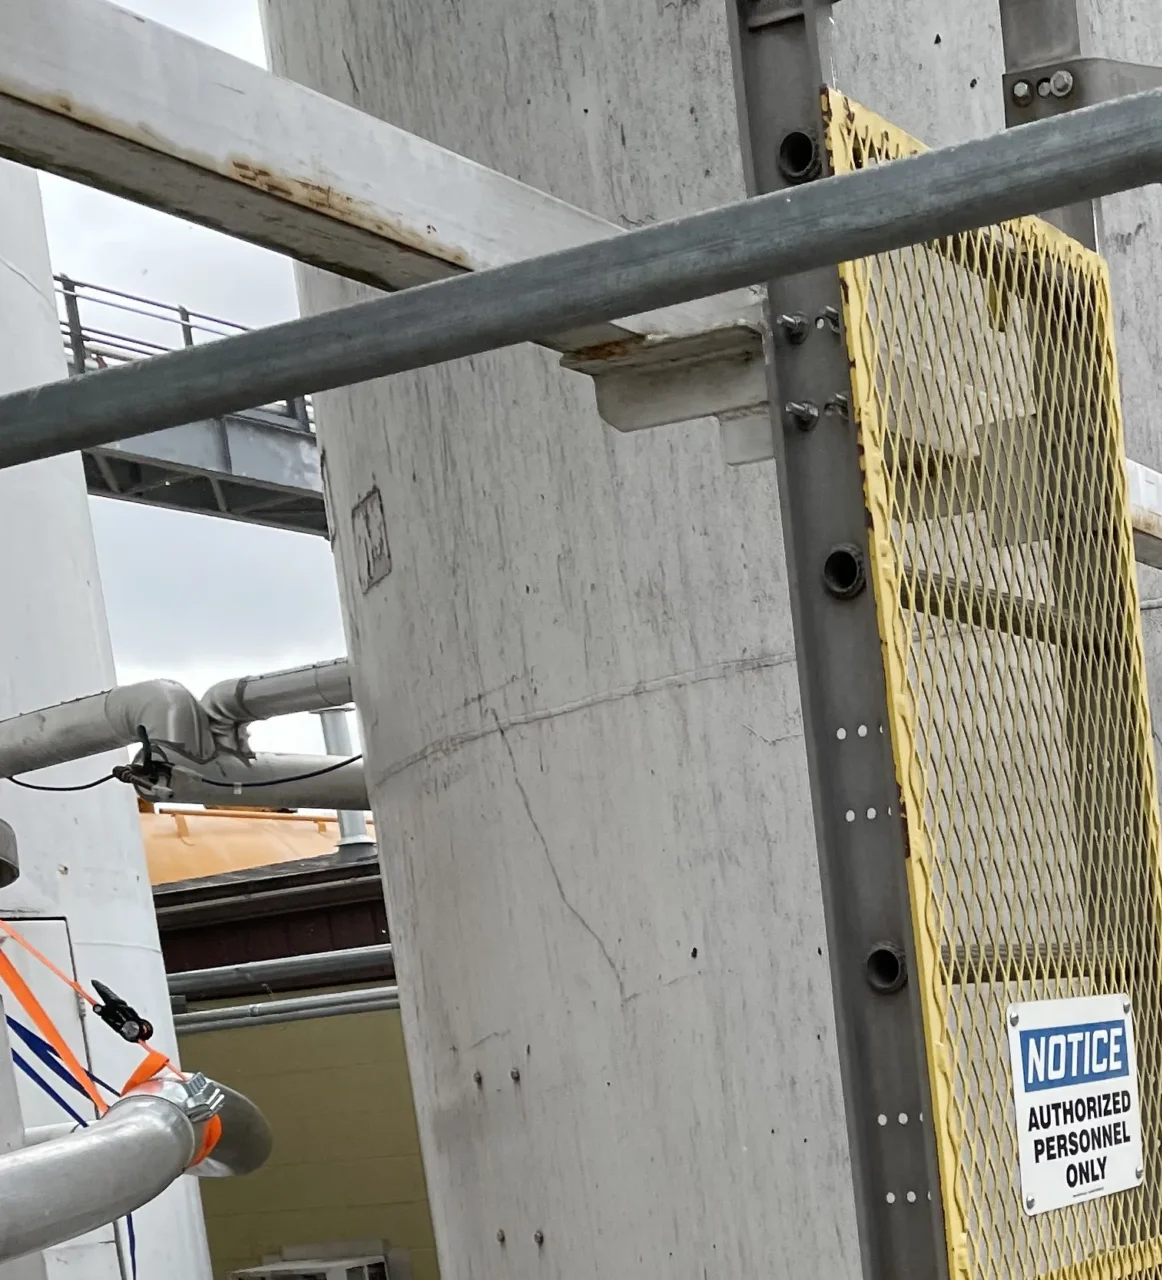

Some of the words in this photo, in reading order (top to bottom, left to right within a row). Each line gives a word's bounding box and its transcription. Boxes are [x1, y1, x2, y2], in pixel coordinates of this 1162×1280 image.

[1027, 1027, 1123, 1084] NOTICE
[1028, 1090, 1131, 1132] AUTHORIZED
[1034, 1120, 1131, 1164] PERSONNEL
[1066, 1156, 1107, 1188] ONLY
